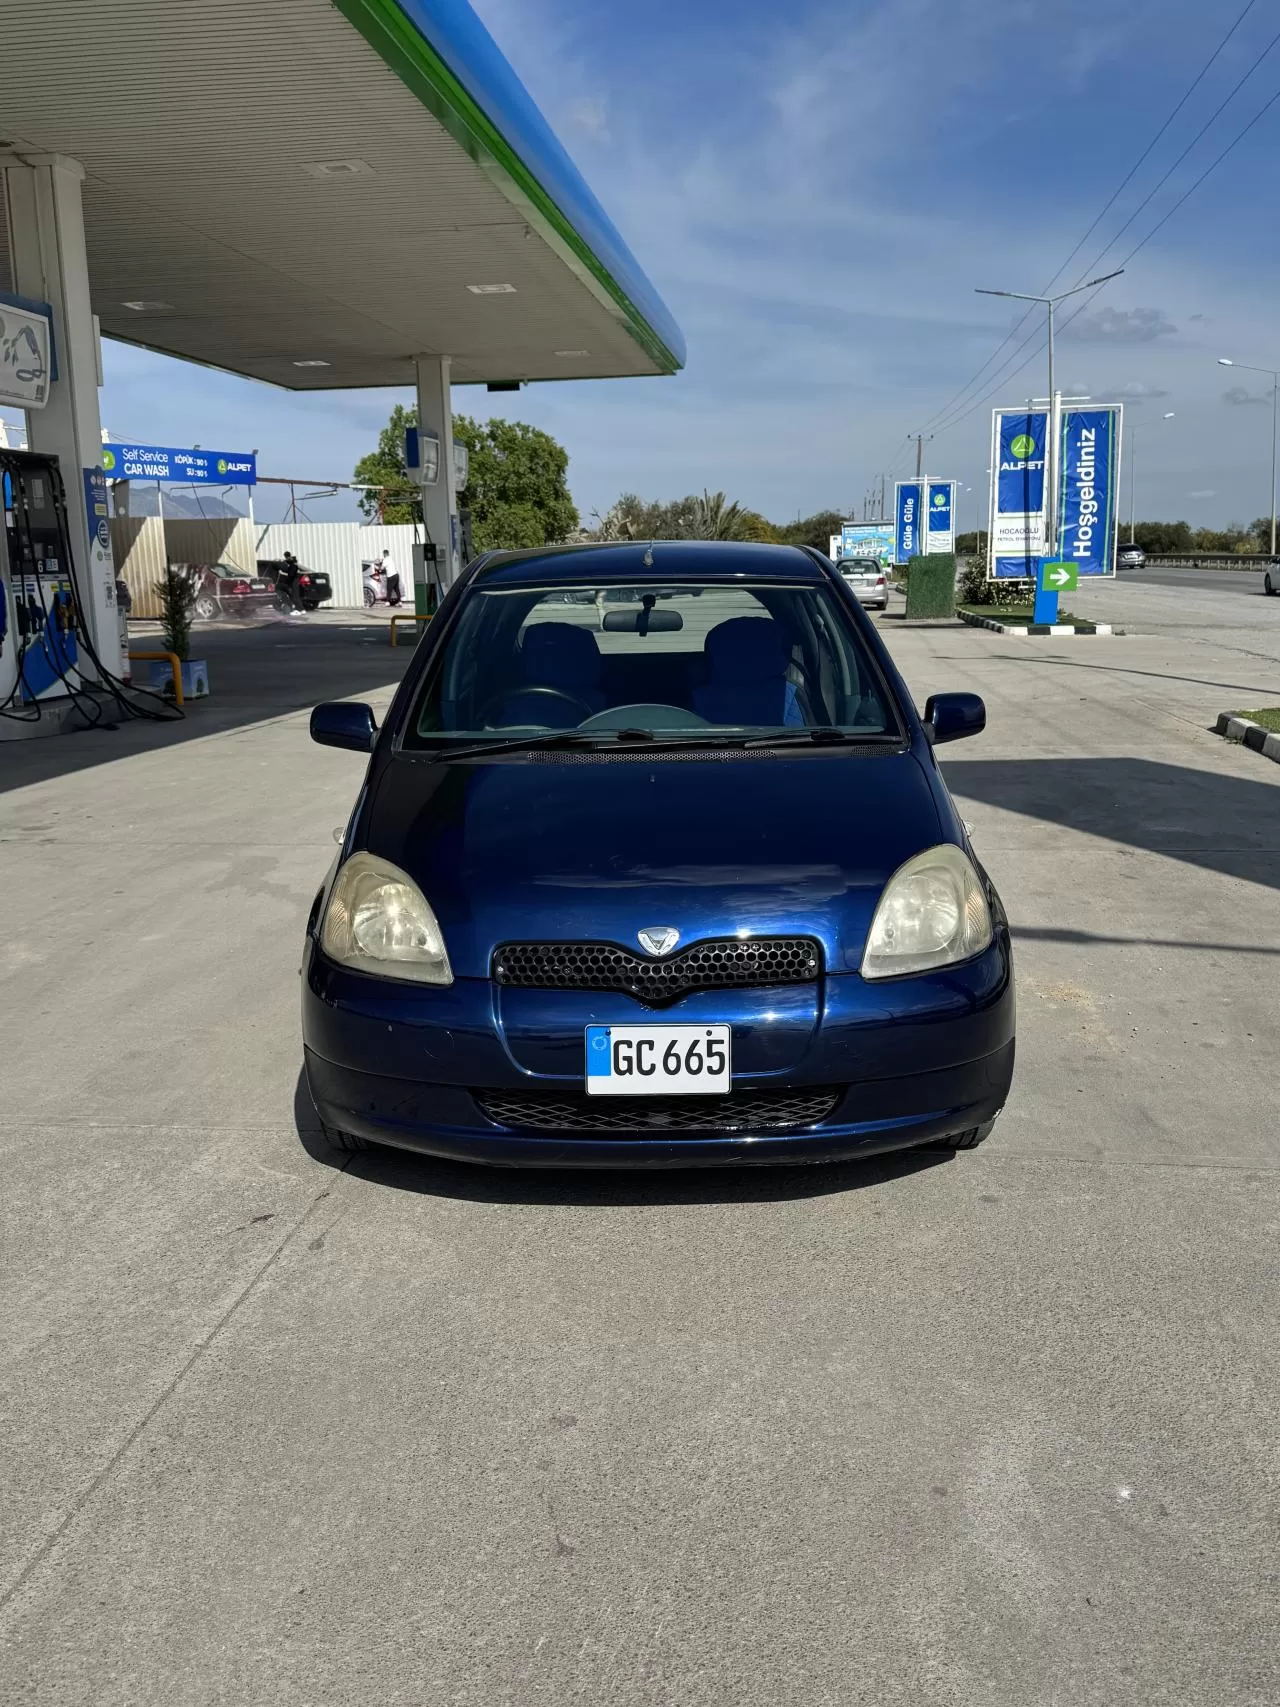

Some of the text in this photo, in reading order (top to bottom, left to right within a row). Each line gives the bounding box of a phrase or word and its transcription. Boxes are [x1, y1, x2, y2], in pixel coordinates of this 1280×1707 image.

[122, 448, 169, 463] Self Service
[124, 462, 170, 477] CAR WASH
[227, 462, 252, 472] ALPET
[1000, 460, 1044, 471] ALPET
[1073, 428, 1097, 557] Hoşgeldiniz
[902, 498, 914, 550] Güle Güle
[37, 560, 44, 573] 6
[613, 1039, 726, 1076] GC 665
